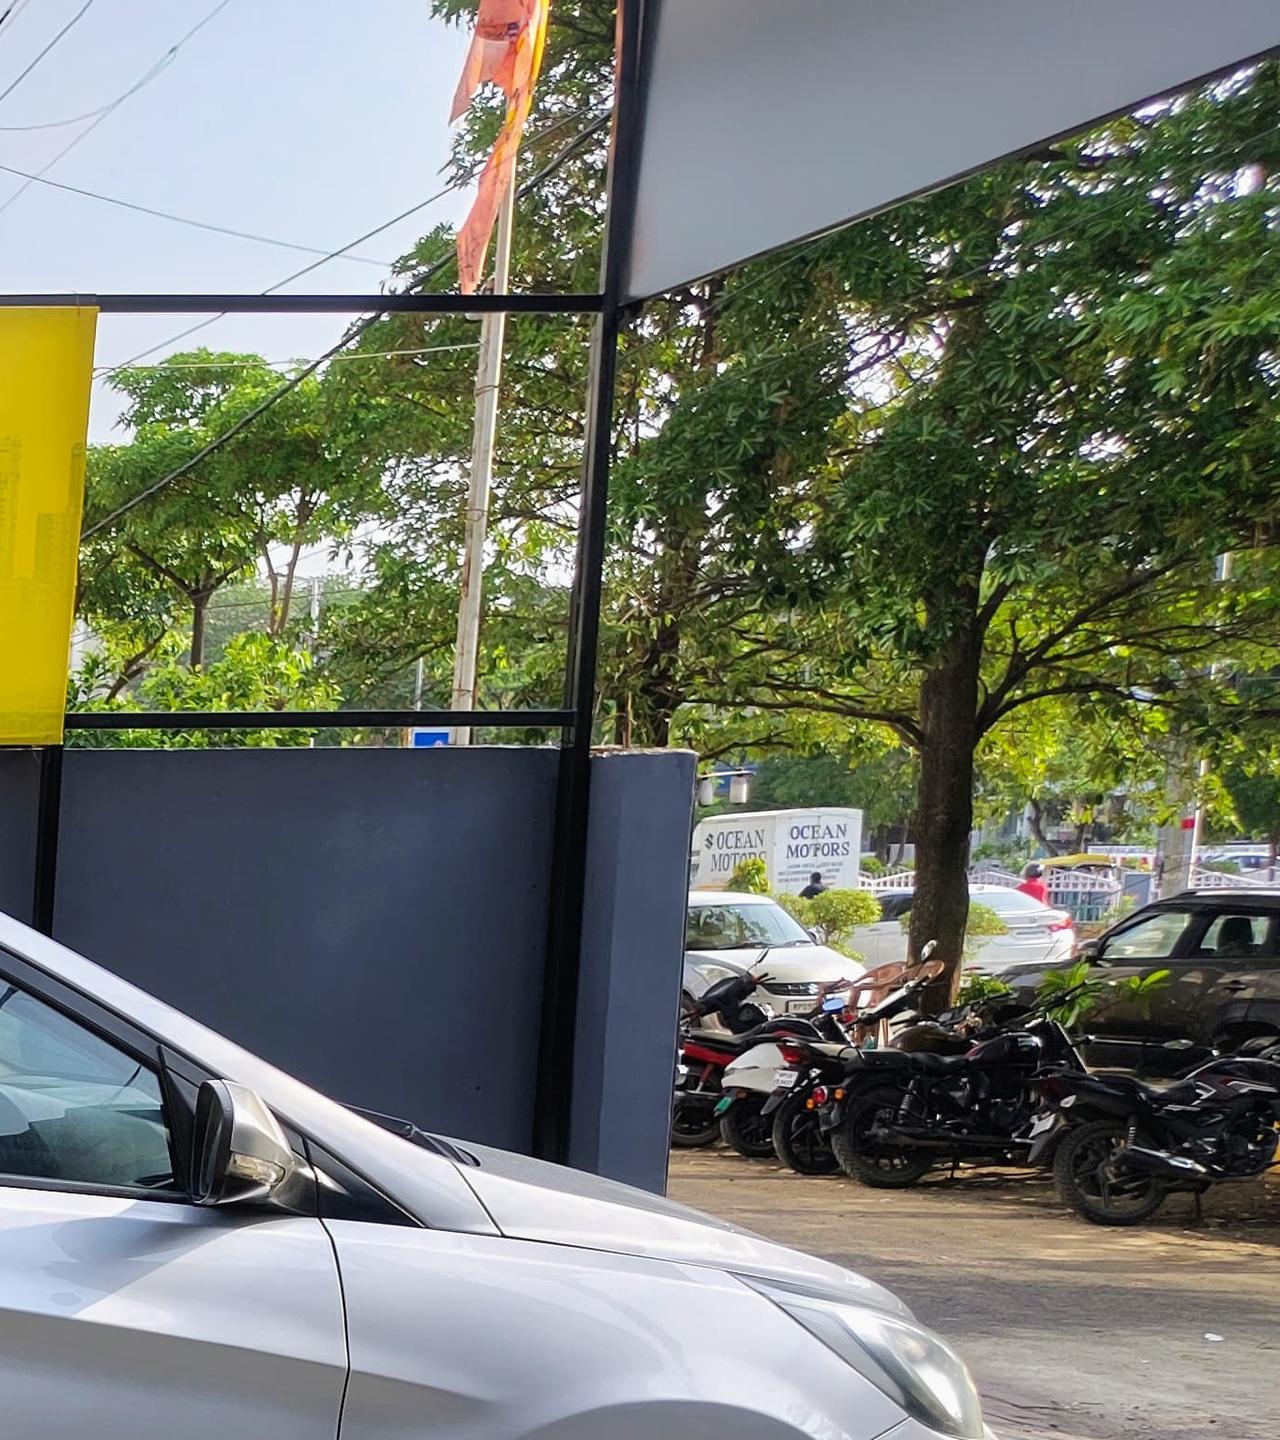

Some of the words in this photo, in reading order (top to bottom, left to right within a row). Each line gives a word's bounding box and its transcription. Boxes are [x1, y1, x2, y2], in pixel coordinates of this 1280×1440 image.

[717, 829, 765, 850] OCEAN
[790, 823, 848, 840] OCEAN
[786, 842, 850, 859] MOTORS
